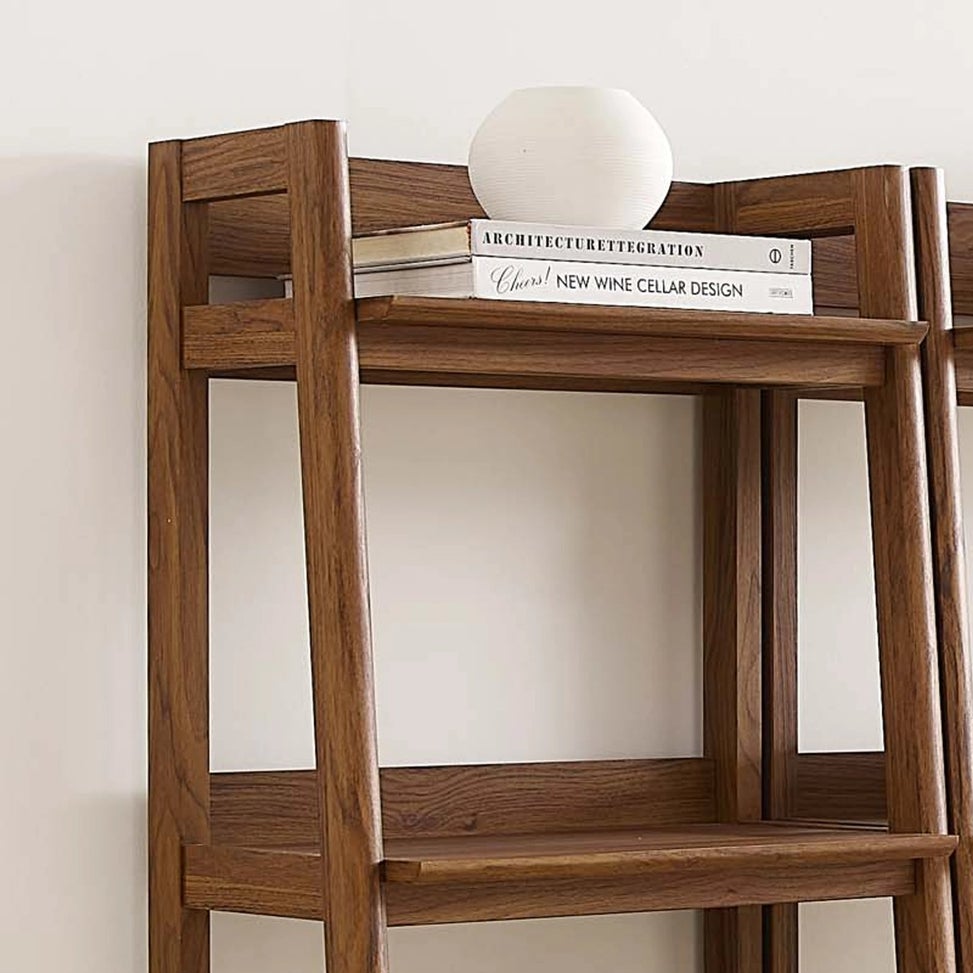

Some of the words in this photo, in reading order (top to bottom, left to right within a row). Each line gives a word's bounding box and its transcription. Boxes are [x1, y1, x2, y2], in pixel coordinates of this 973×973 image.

[483, 232, 704, 257] ARCHITECTURETTEGRATION
[557, 275, 590, 289] NEW
[595, 276, 632, 292] WINE
[637, 279, 687, 294] CELLAR
[691, 281, 743, 297] DESIGN
